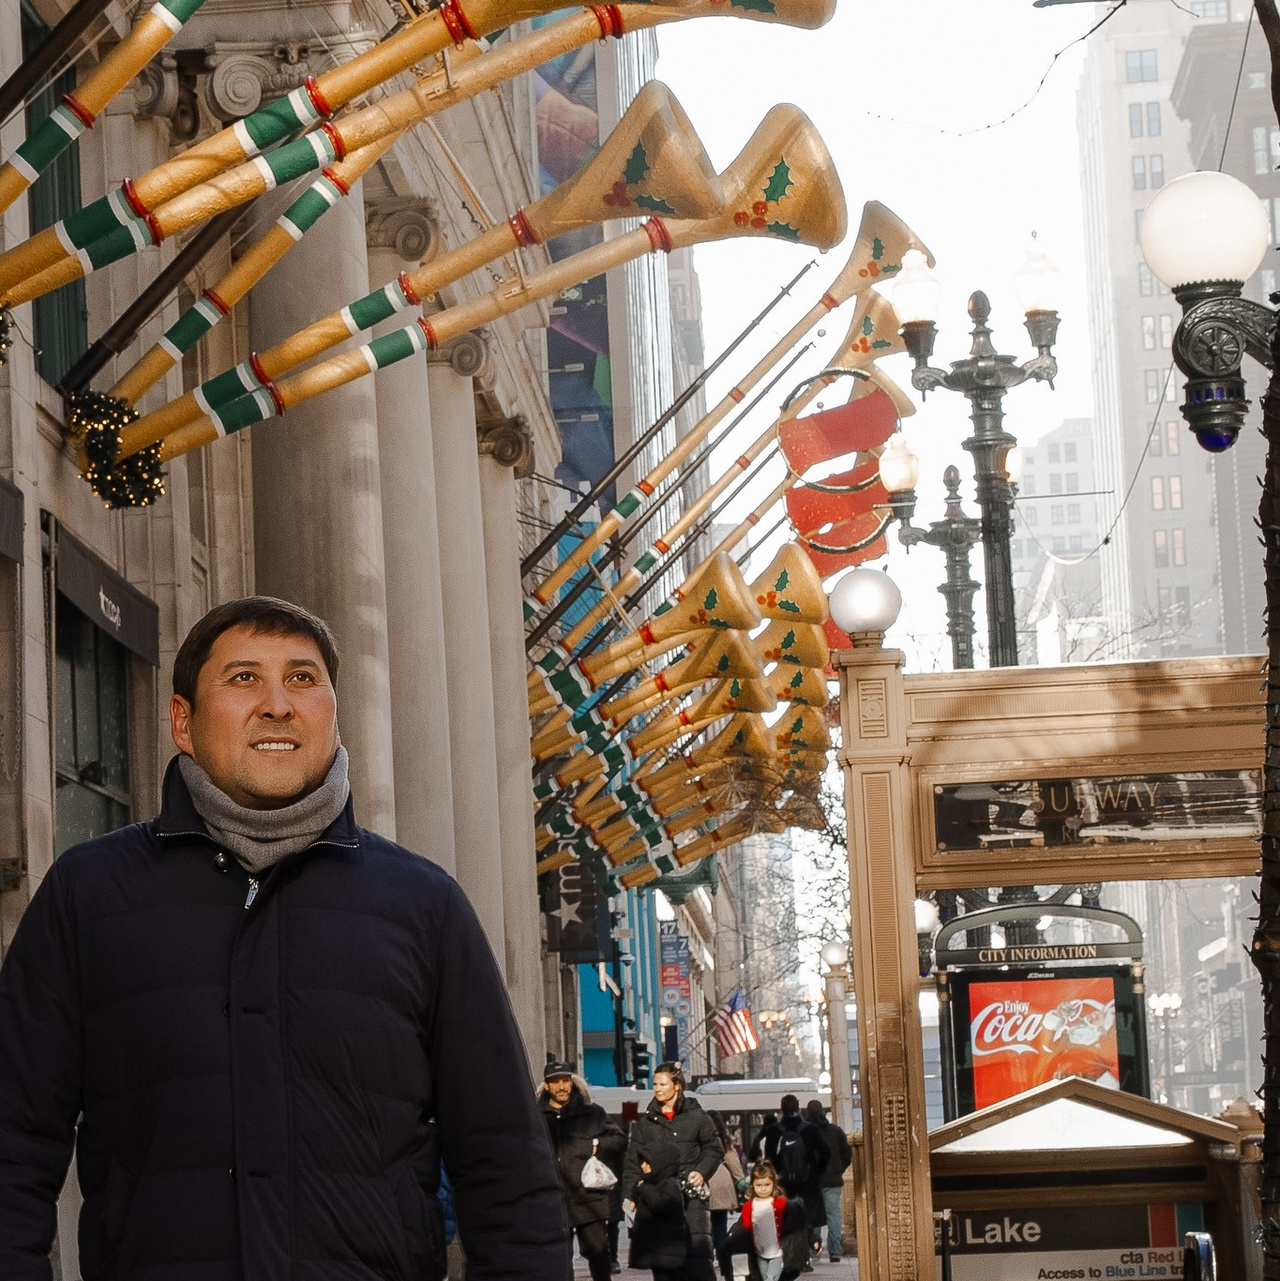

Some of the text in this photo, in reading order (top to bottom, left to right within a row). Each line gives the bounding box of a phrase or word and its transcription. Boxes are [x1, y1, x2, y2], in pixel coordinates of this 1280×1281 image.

[979, 946, 1096, 961] CITY INFORMATION
[1004, 1001, 1029, 1015] Enjoy
[970, 1001, 1043, 1056] Coca
[966, 1217, 1042, 1244] Lake
[1120, 1251, 1144, 1264] cta
[1148, 1251, 1175, 1263] Red
[1037, 1268, 1086, 1280] Access
[1088, 1267, 1102, 1278] to
[1105, 1265, 1136, 1277] Blue
[1139, 1264, 1168, 1276] Line
